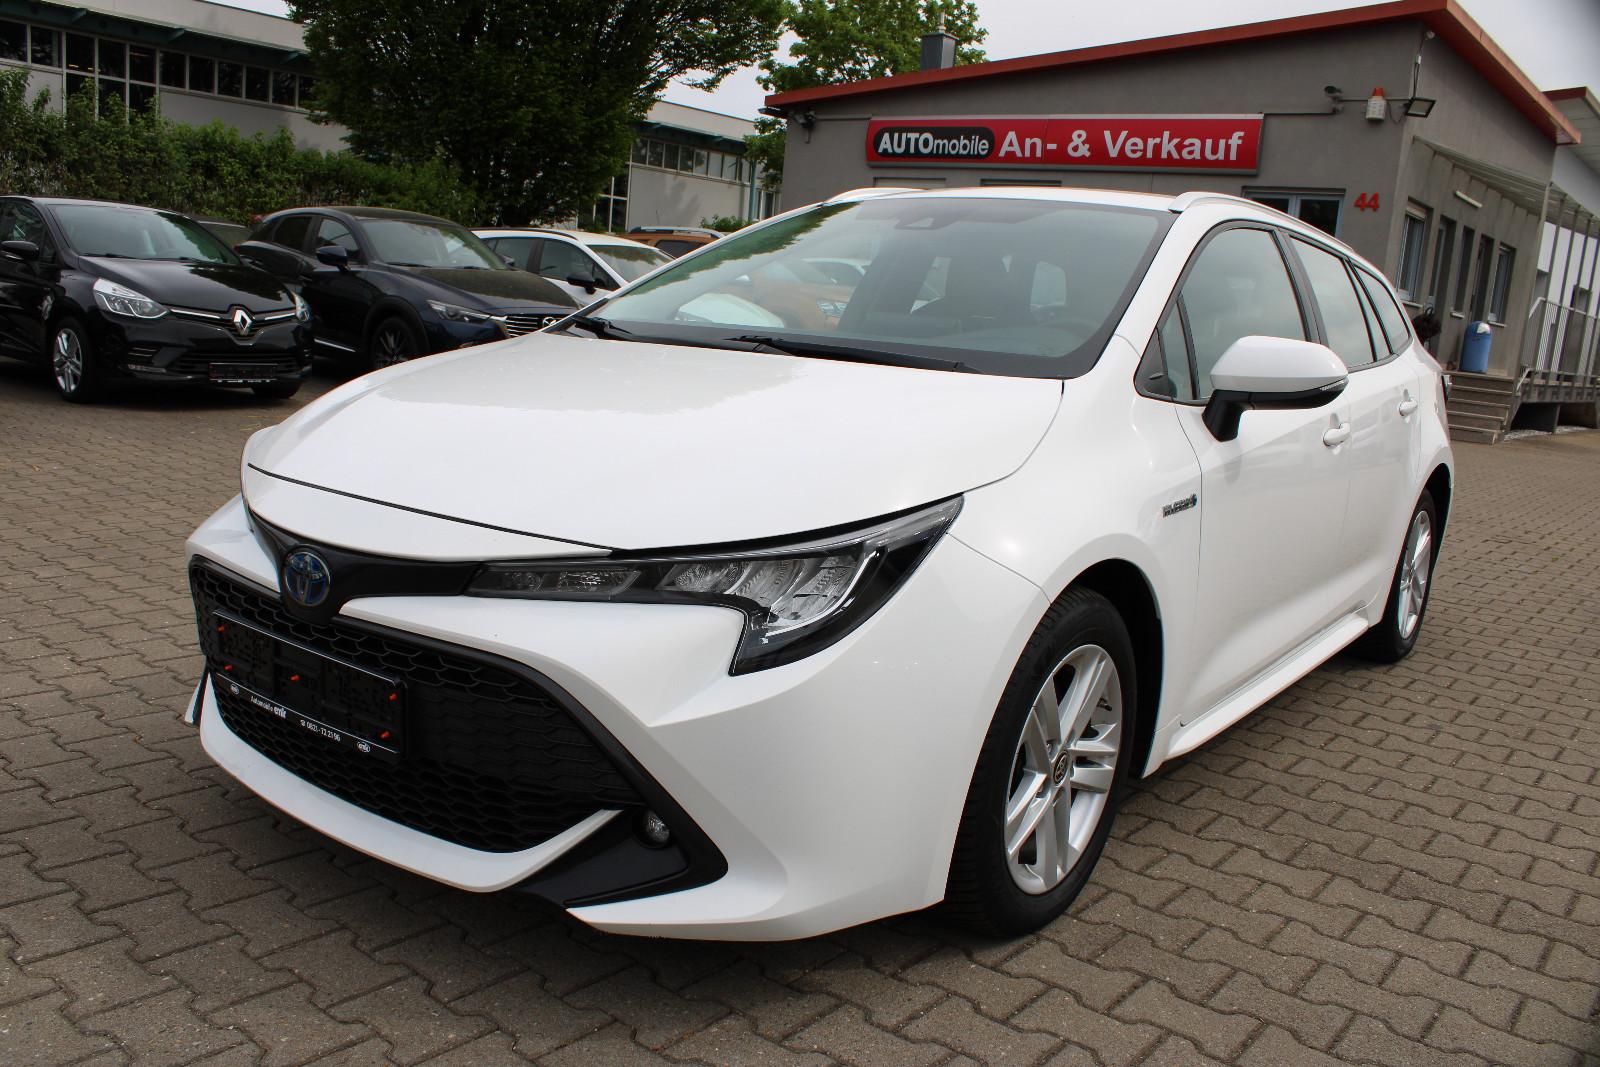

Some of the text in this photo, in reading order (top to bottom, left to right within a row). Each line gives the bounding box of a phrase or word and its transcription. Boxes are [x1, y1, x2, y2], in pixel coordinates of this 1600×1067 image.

[878, 129, 1244, 161] AUTOmobile An- & Verkauf
[1354, 192, 1380, 212] 44
